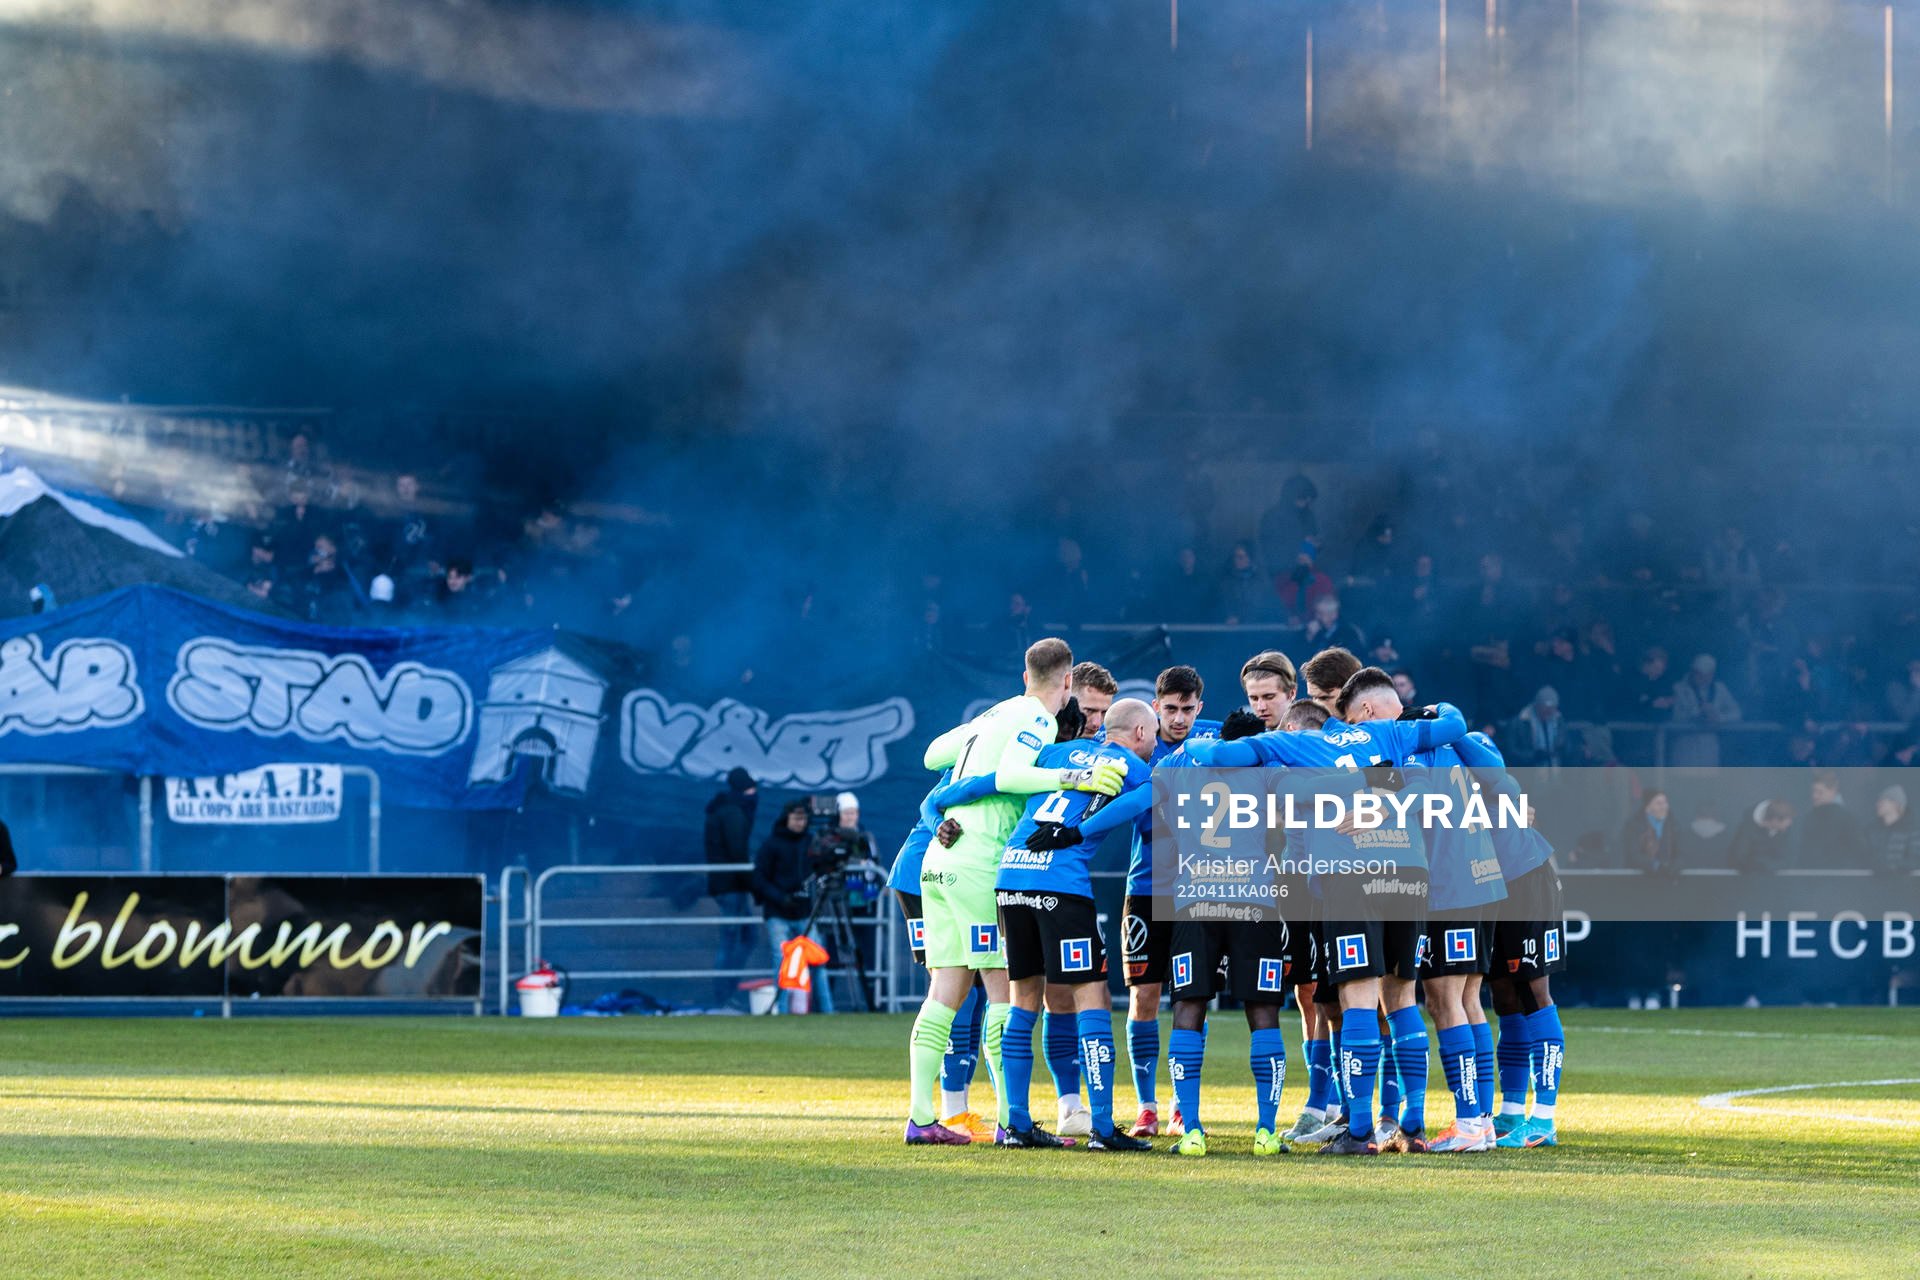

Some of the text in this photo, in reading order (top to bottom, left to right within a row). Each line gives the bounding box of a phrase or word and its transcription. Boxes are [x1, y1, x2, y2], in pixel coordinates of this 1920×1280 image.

[0, 633, 146, 737] ÅR
[166, 636, 472, 757] STAD
[176, 800, 336, 817] ALL COPS ARE BASTARDS
[1200, 781, 1231, 849] 2
[52, 891, 452, 969] blommor
[1522, 938, 1536, 955] 10
[1736, 910, 1916, 959] HECB
